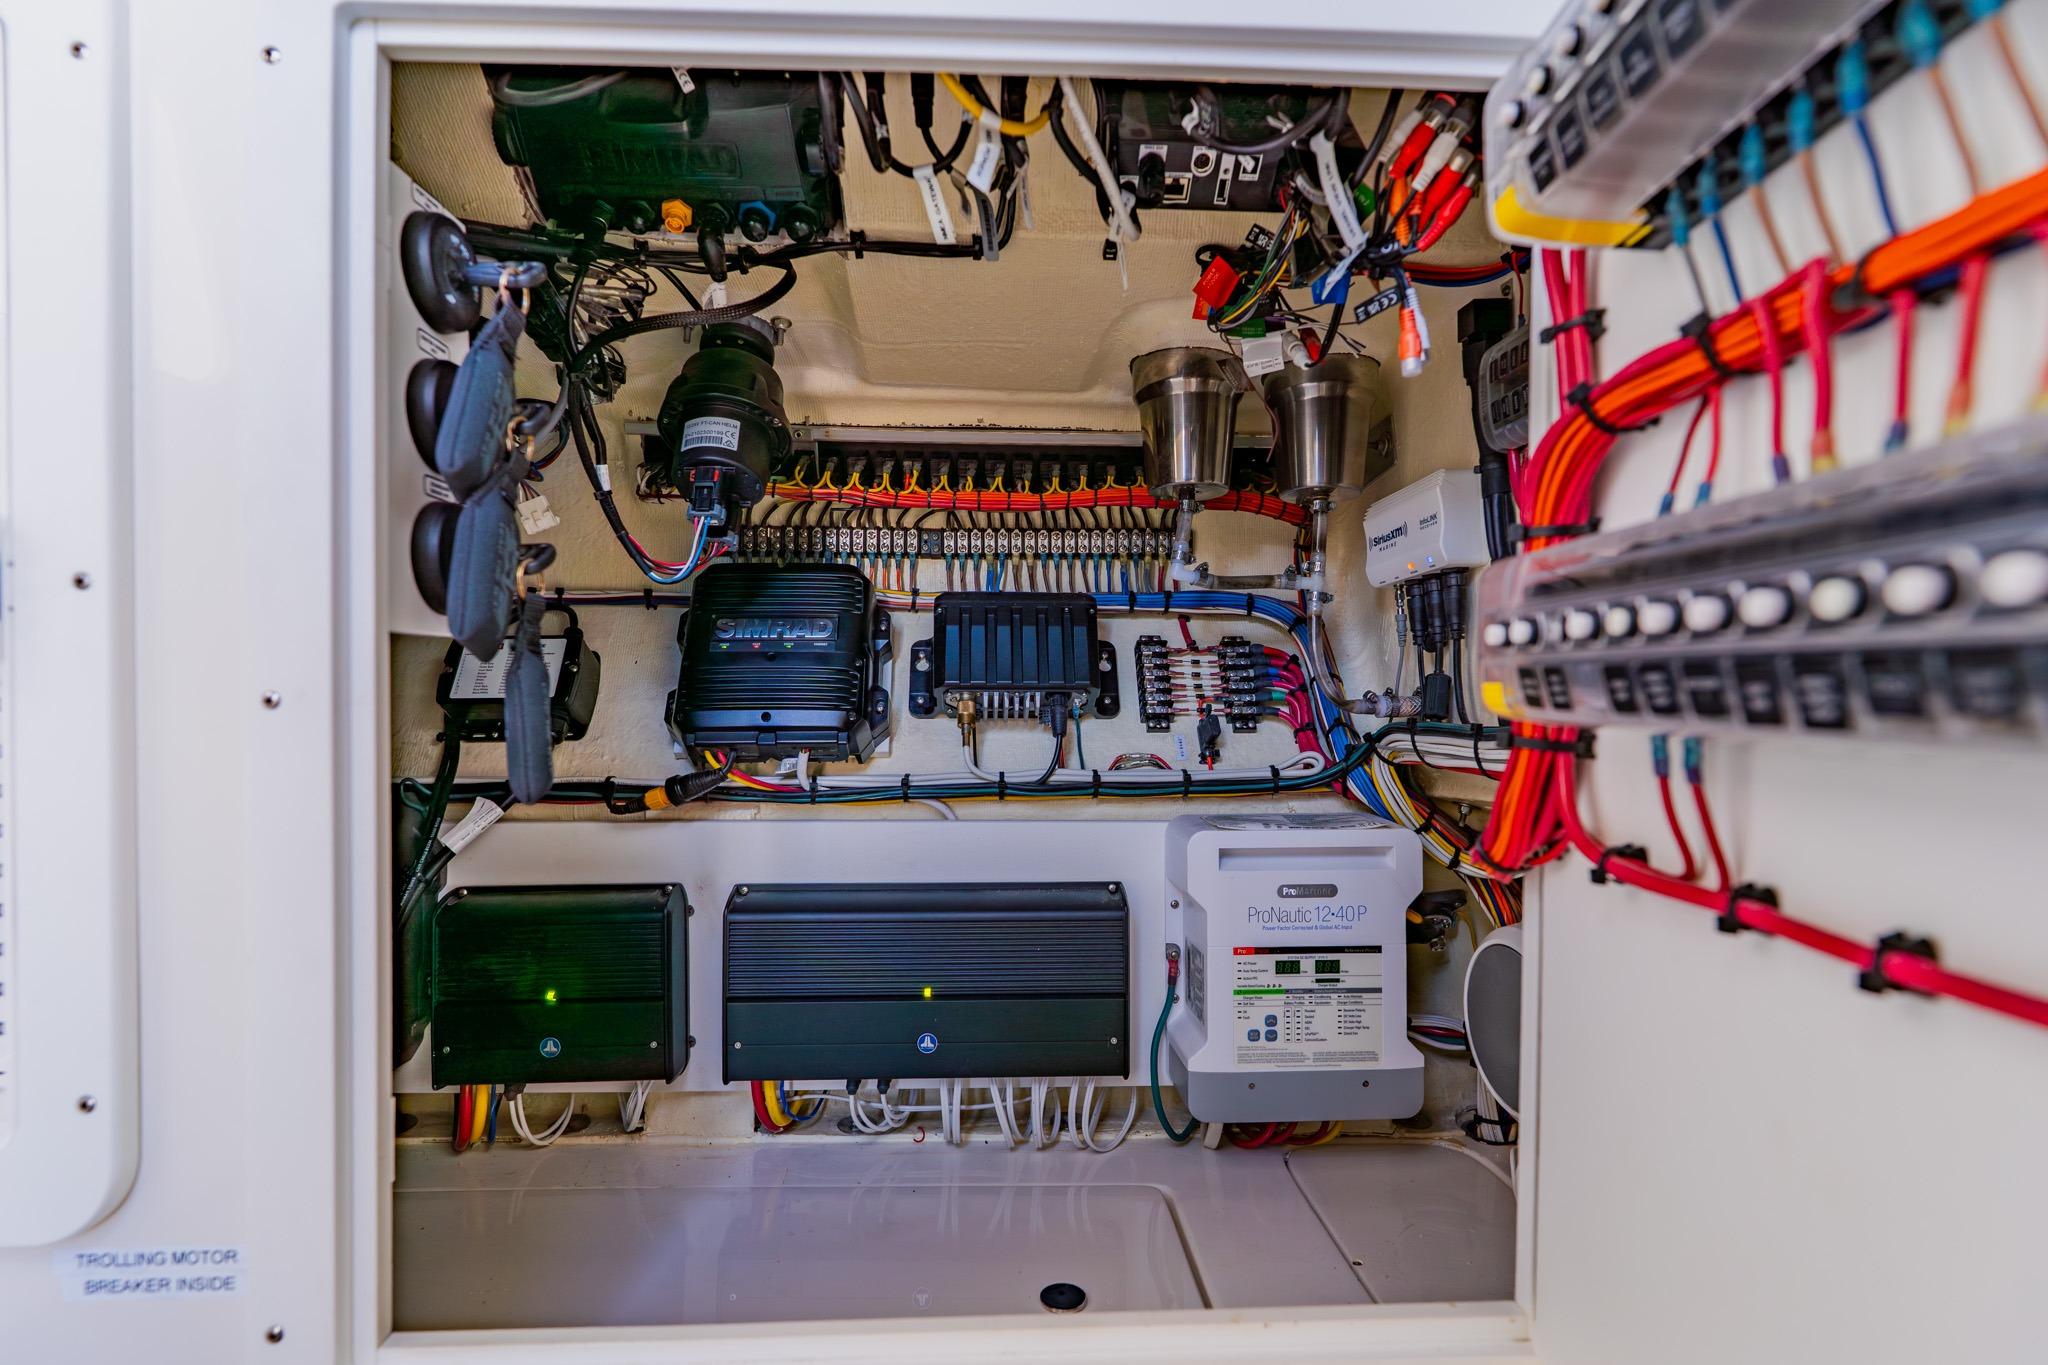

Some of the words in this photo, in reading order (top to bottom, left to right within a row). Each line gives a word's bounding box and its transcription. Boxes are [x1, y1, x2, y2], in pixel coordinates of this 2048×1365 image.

[715, 618, 834, 638] SIMRAD
[1248, 906, 1312, 924] ProNautic
[76, 1252, 167, 1269] TROLLING
[171, 1249, 238, 1266] MOTOR
[84, 1278, 171, 1295] BREAKER
[175, 1276, 237, 1293] INSIDE
